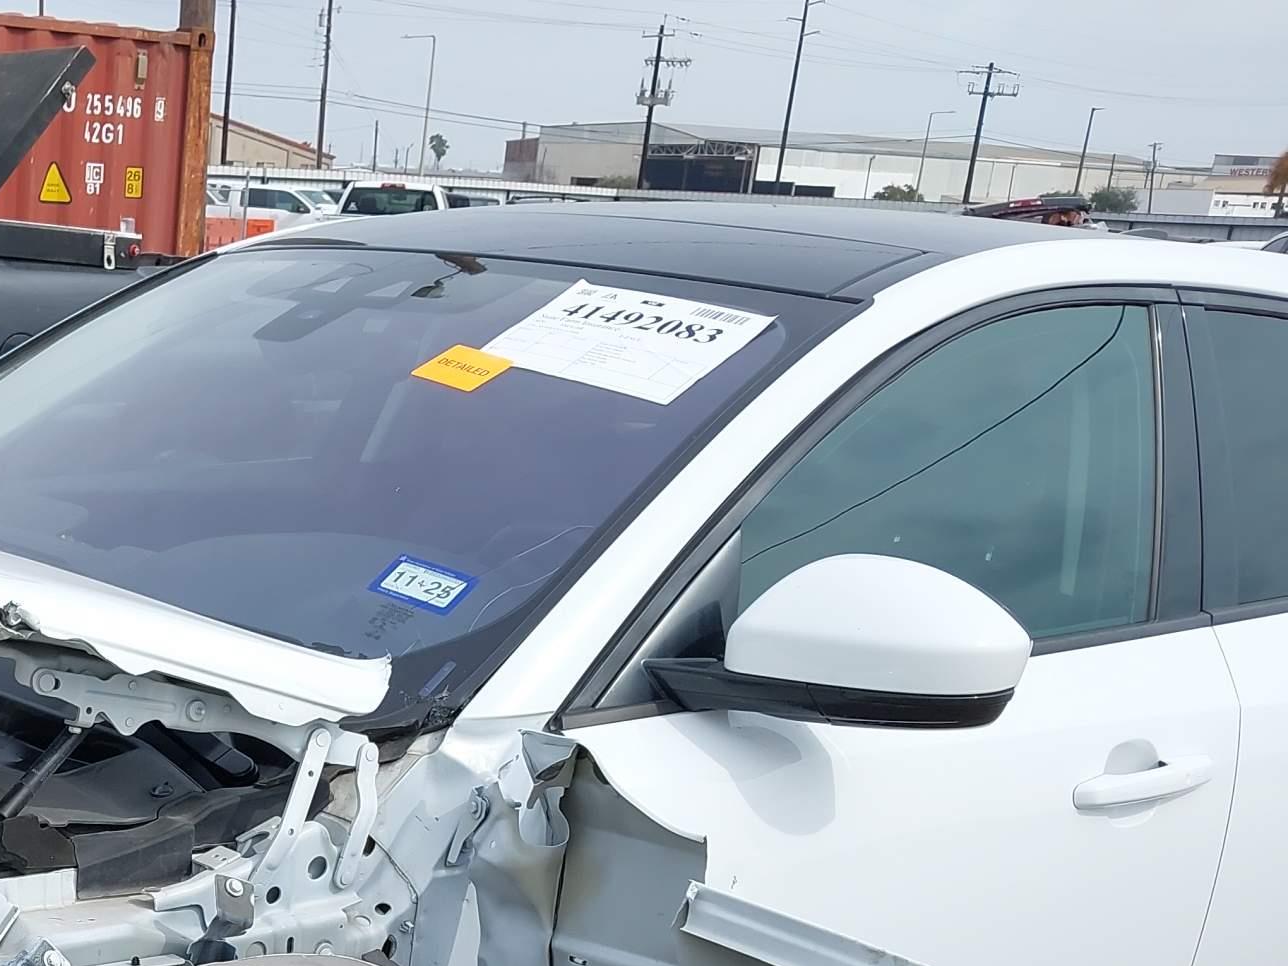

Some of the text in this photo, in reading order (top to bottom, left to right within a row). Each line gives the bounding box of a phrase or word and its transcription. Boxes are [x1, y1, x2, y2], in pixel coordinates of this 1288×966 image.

[84, 120, 124, 145] 42G1
[86, 183, 100, 195] 81
[562, 303, 724, 344] 41492083
[437, 357, 490, 376] DETAILED
